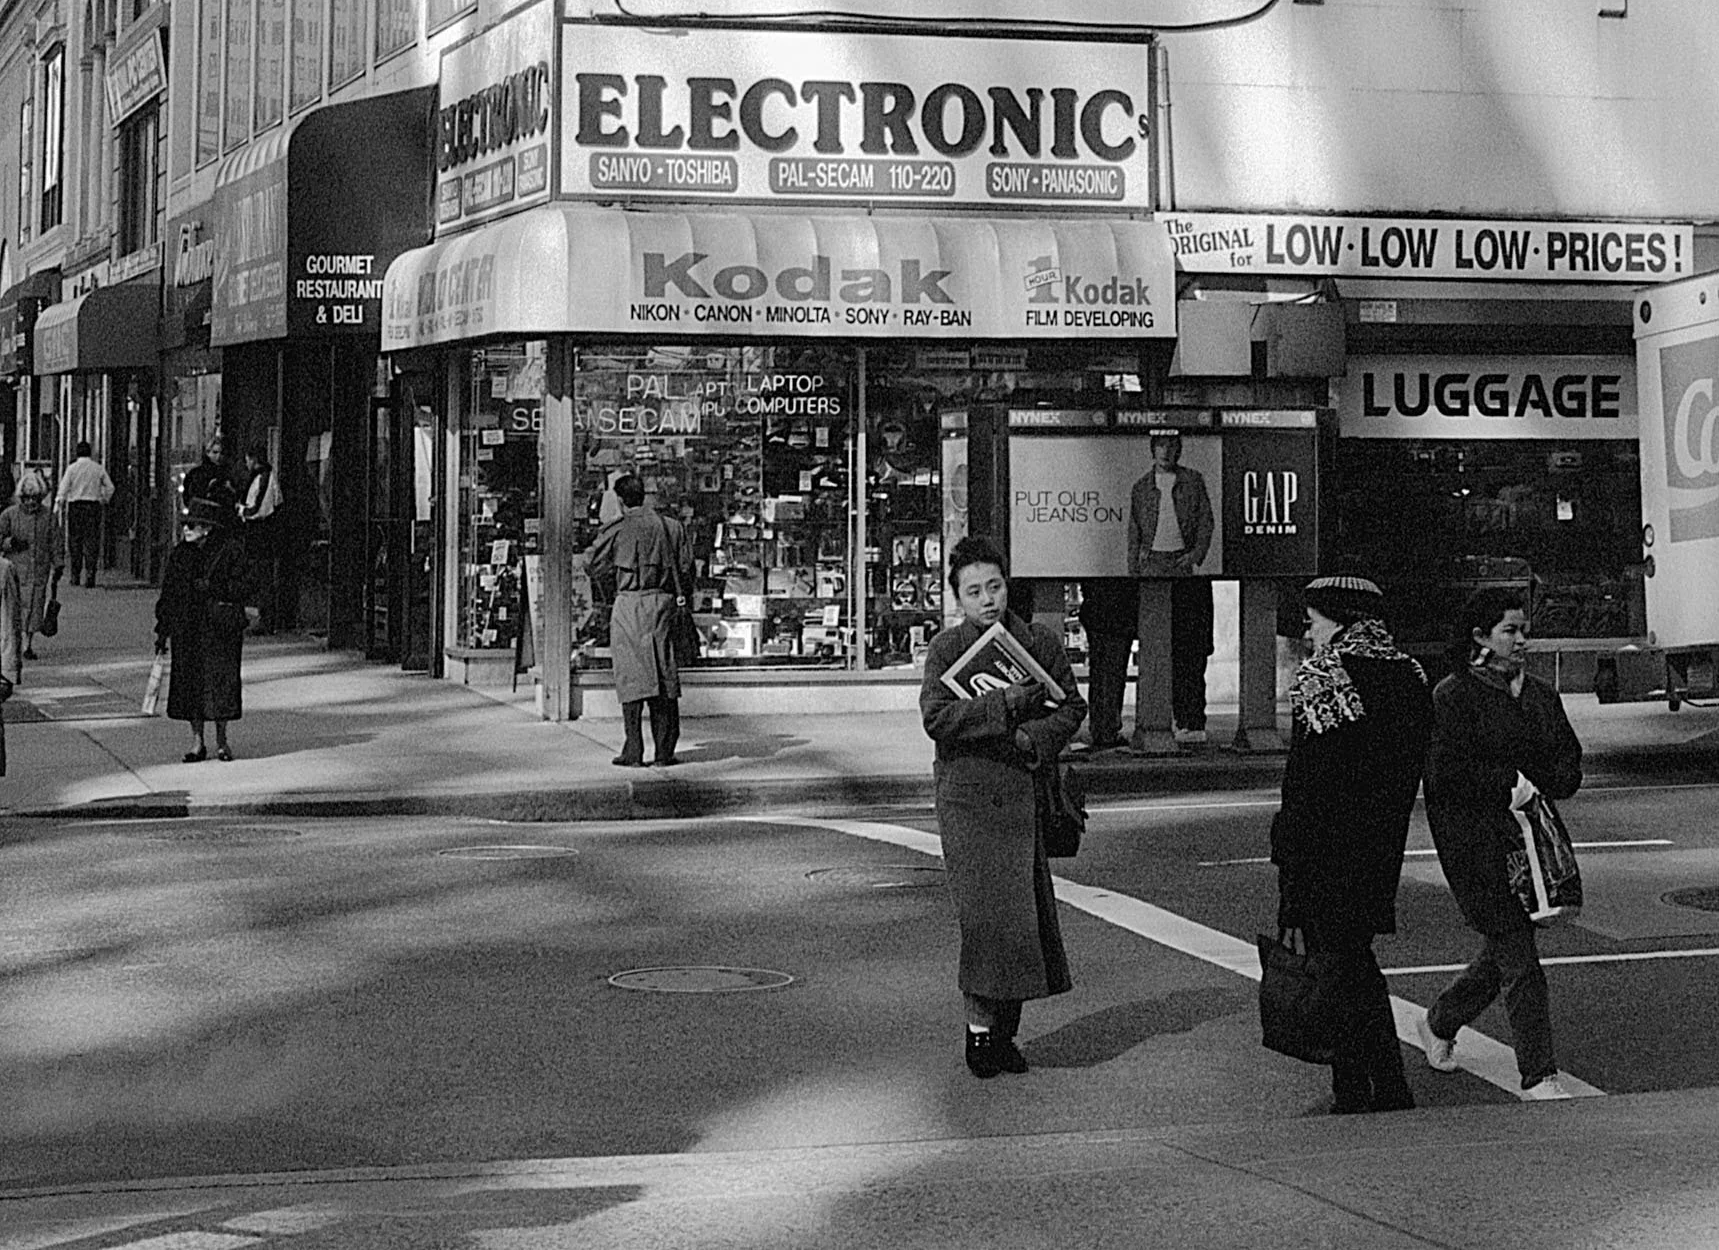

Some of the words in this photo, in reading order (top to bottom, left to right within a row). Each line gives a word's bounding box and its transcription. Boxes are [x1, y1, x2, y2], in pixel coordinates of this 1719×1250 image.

[598, 157, 651, 183] SANYO
[666, 159, 732, 185] TOSHIBA
[778, 162, 874, 188] PAL-SECAM
[889, 164, 951, 190] 110-220
[992, 167, 1030, 192] SONY
[1041, 170, 1118, 194] PANASONIC
[1163, 219, 1193, 235] The
[1265, 223, 1344, 266] LOW
[1361, 226, 1439, 268] LOW
[1455, 228, 1531, 271] LOW
[1547, 231, 1682, 273] PRICES!
[306, 255, 375, 274] GOURMET
[1230, 251, 1253, 267] for
[643, 251, 955, 304] Kodak
[1028, 271, 1058, 287] HOUR
[296, 280, 384, 299] RESTAURANT
[1065, 275, 1153, 306] Kodak
[315, 304, 327, 324] &
[333, 304, 363, 324] DELI
[630, 304, 680, 322] NIKON
[694, 304, 753, 323] CANON
[766, 306, 832, 324] MINOLTA
[846, 308, 890, 325] SONY
[903, 310, 972, 327] RAY-BAN
[1026, 310, 1058, 326] FILM
[1064, 310, 1155, 329] DEVELOPING
[626, 374, 680, 400] PAL
[748, 374, 824, 394] LAPTOP
[735, 396, 841, 415] COMPUTERS
[1363, 373, 1622, 419] LUGGAGE
[599, 407, 701, 434] SECAM
[1010, 411, 1061, 425] NYNEX
[1118, 411, 1167, 425] NYNEX
[1221, 411, 1270, 425] NYNEX
[1015, 490, 1053, 507] PUT
[1057, 490, 1100, 507] OUR
[1243, 471, 1298, 524] GAP
[1026, 507, 1088, 523] JEANS
[1093, 507, 1123, 523] ON
[1244, 524, 1298, 535] DENIM
